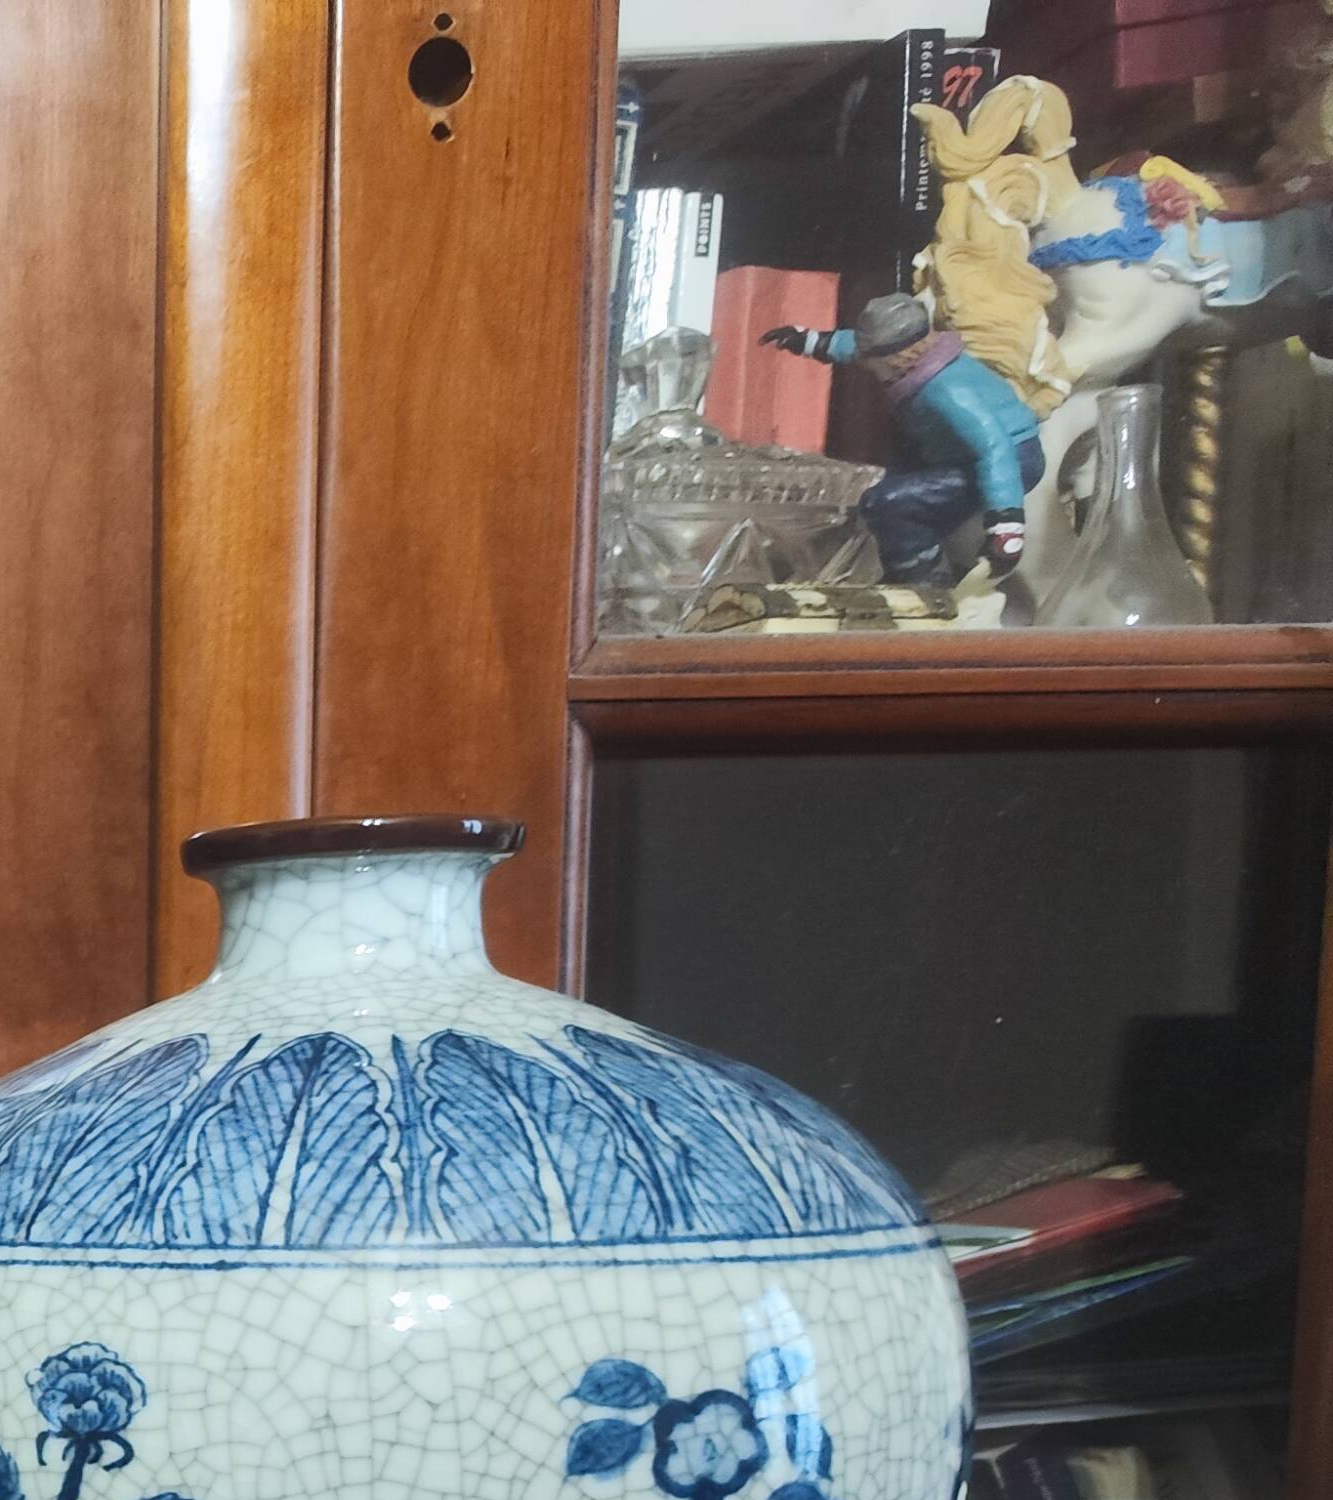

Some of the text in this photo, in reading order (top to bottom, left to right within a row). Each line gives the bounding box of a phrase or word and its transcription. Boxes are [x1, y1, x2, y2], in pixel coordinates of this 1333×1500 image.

[920, 40, 934, 78] 1998
[942, 65, 983, 108] 97
[696, 202, 712, 253] POINTS
